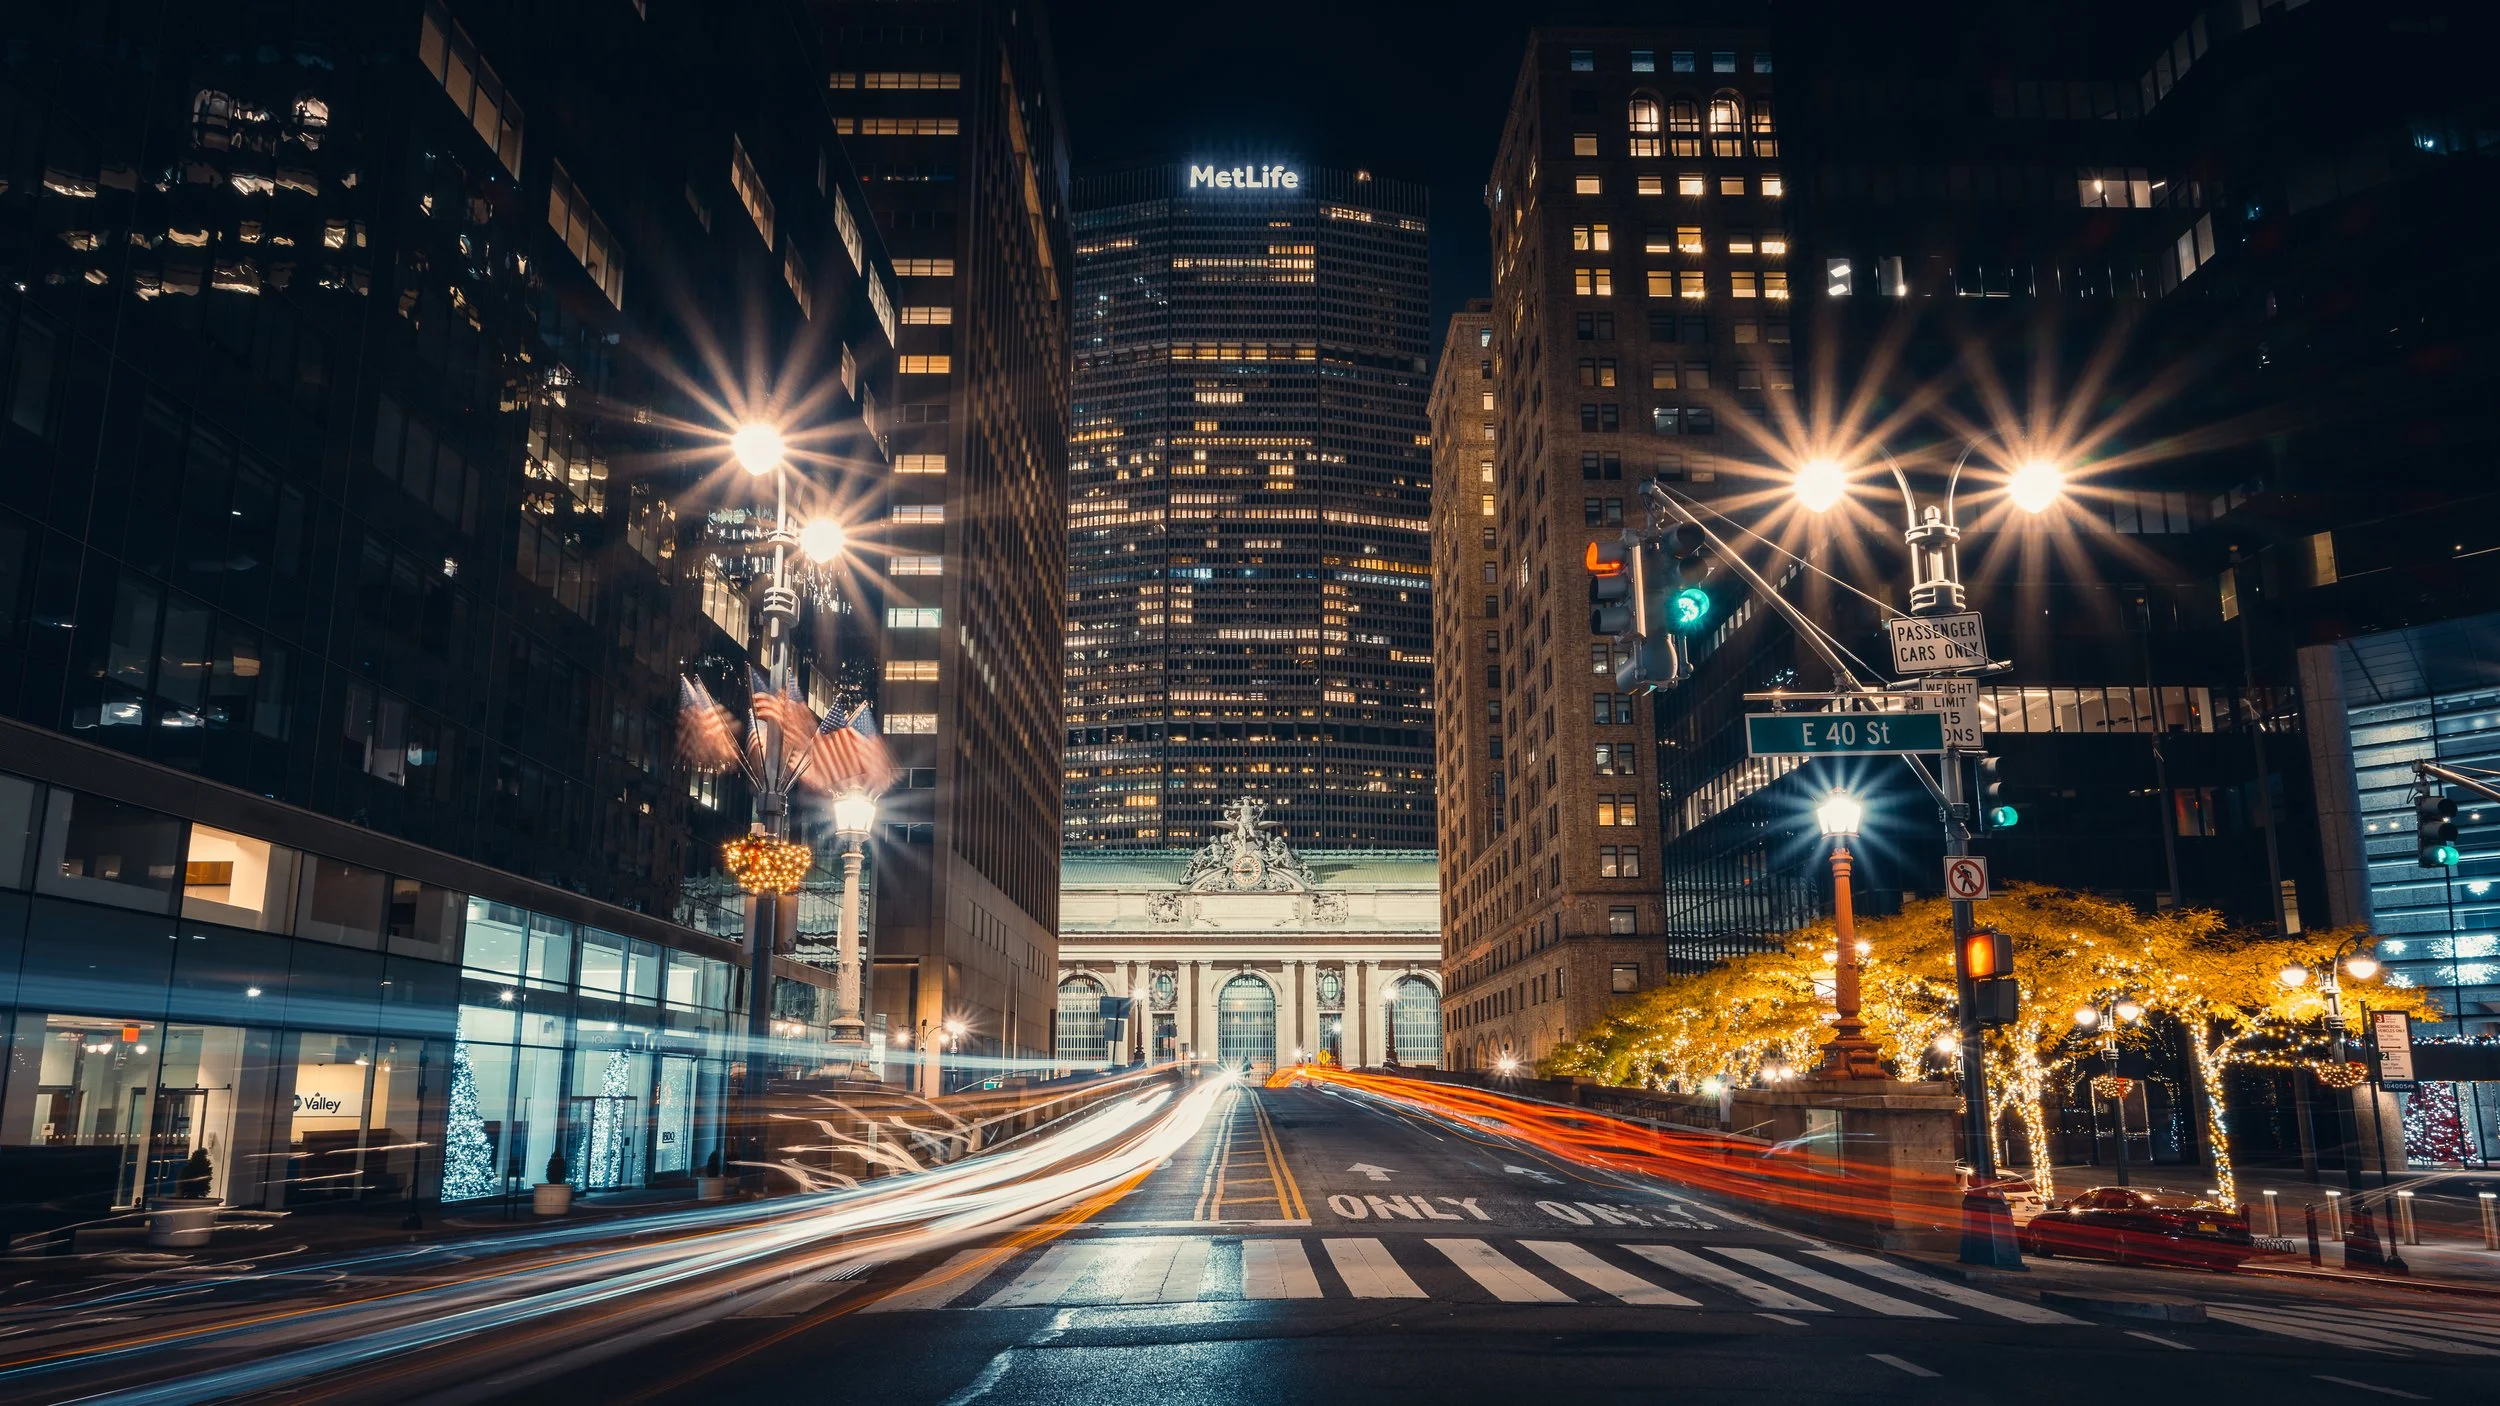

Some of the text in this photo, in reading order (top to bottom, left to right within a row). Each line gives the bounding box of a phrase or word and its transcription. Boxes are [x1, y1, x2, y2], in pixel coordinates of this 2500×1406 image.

[1190, 165, 1299, 188] MetLife
[1897, 621, 1977, 642] PASSENGER
[1900, 641, 1979, 663] CARS ONLY
[1925, 683, 1973, 694] WEIGHT
[1933, 697, 1967, 708] LIMIT
[1942, 712, 1961, 725] 15
[1802, 721, 1891, 746] E 40 St
[1945, 728, 1975, 742] ONS
[2376, 1014, 2383, 1023] 3
[2381, 1052, 2388, 1060] 2
[304, 1097, 341, 1114] Valley
[1327, 1194, 1493, 1221] ONLY
